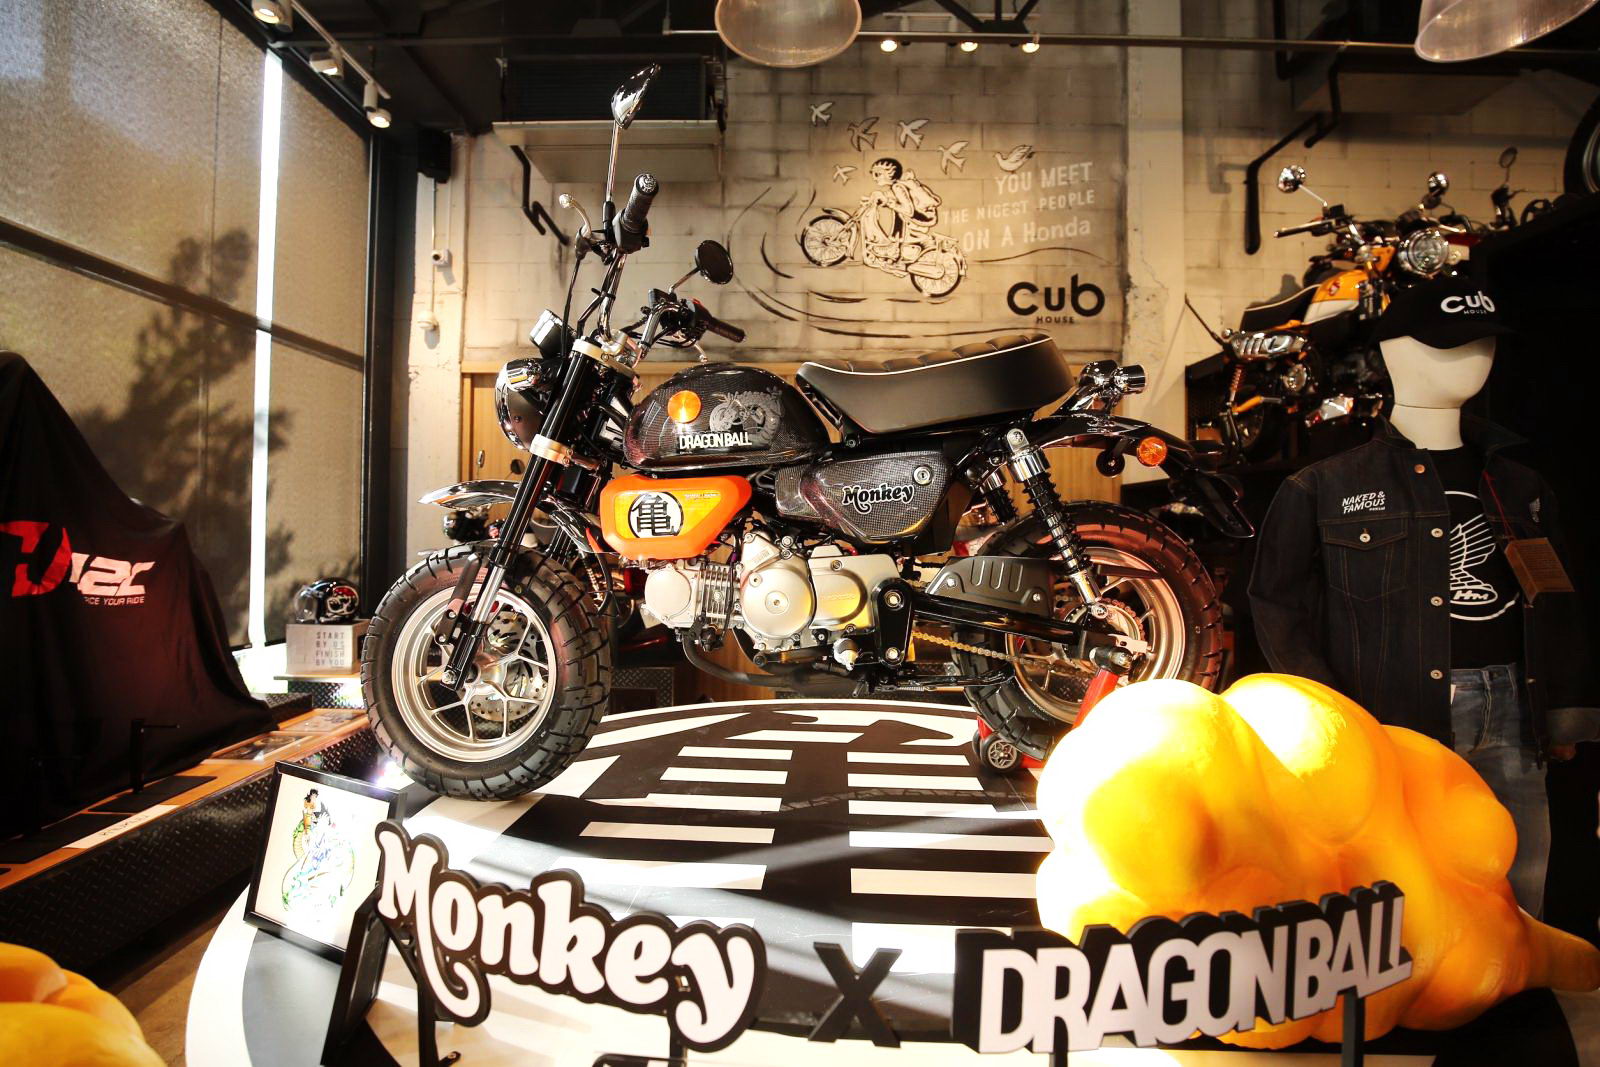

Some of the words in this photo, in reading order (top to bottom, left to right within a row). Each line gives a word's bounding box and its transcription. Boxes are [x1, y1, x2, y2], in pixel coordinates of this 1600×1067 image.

[994, 172, 1032, 195] YOU
[1041, 162, 1094, 188] MEET
[943, 209, 969, 225] THE
[976, 201, 1029, 220] NICEST
[1039, 190, 1095, 211] PEOPLE
[962, 230, 990, 251] ON
[1001, 226, 1014, 247] A
[1023, 217, 1091, 243] Honda
[1007, 273, 1105, 317] Cub
[1441, 290, 1495, 313] Cub
[1036, 316, 1075, 324] HOUSE
[842, 483, 914, 514] Monkey
[1342, 492, 1377, 507] NAKED
[1343, 498, 1386, 514] FAMOUS
[316, 631, 344, 640] START
[375, 829, 757, 1046] Monkey
